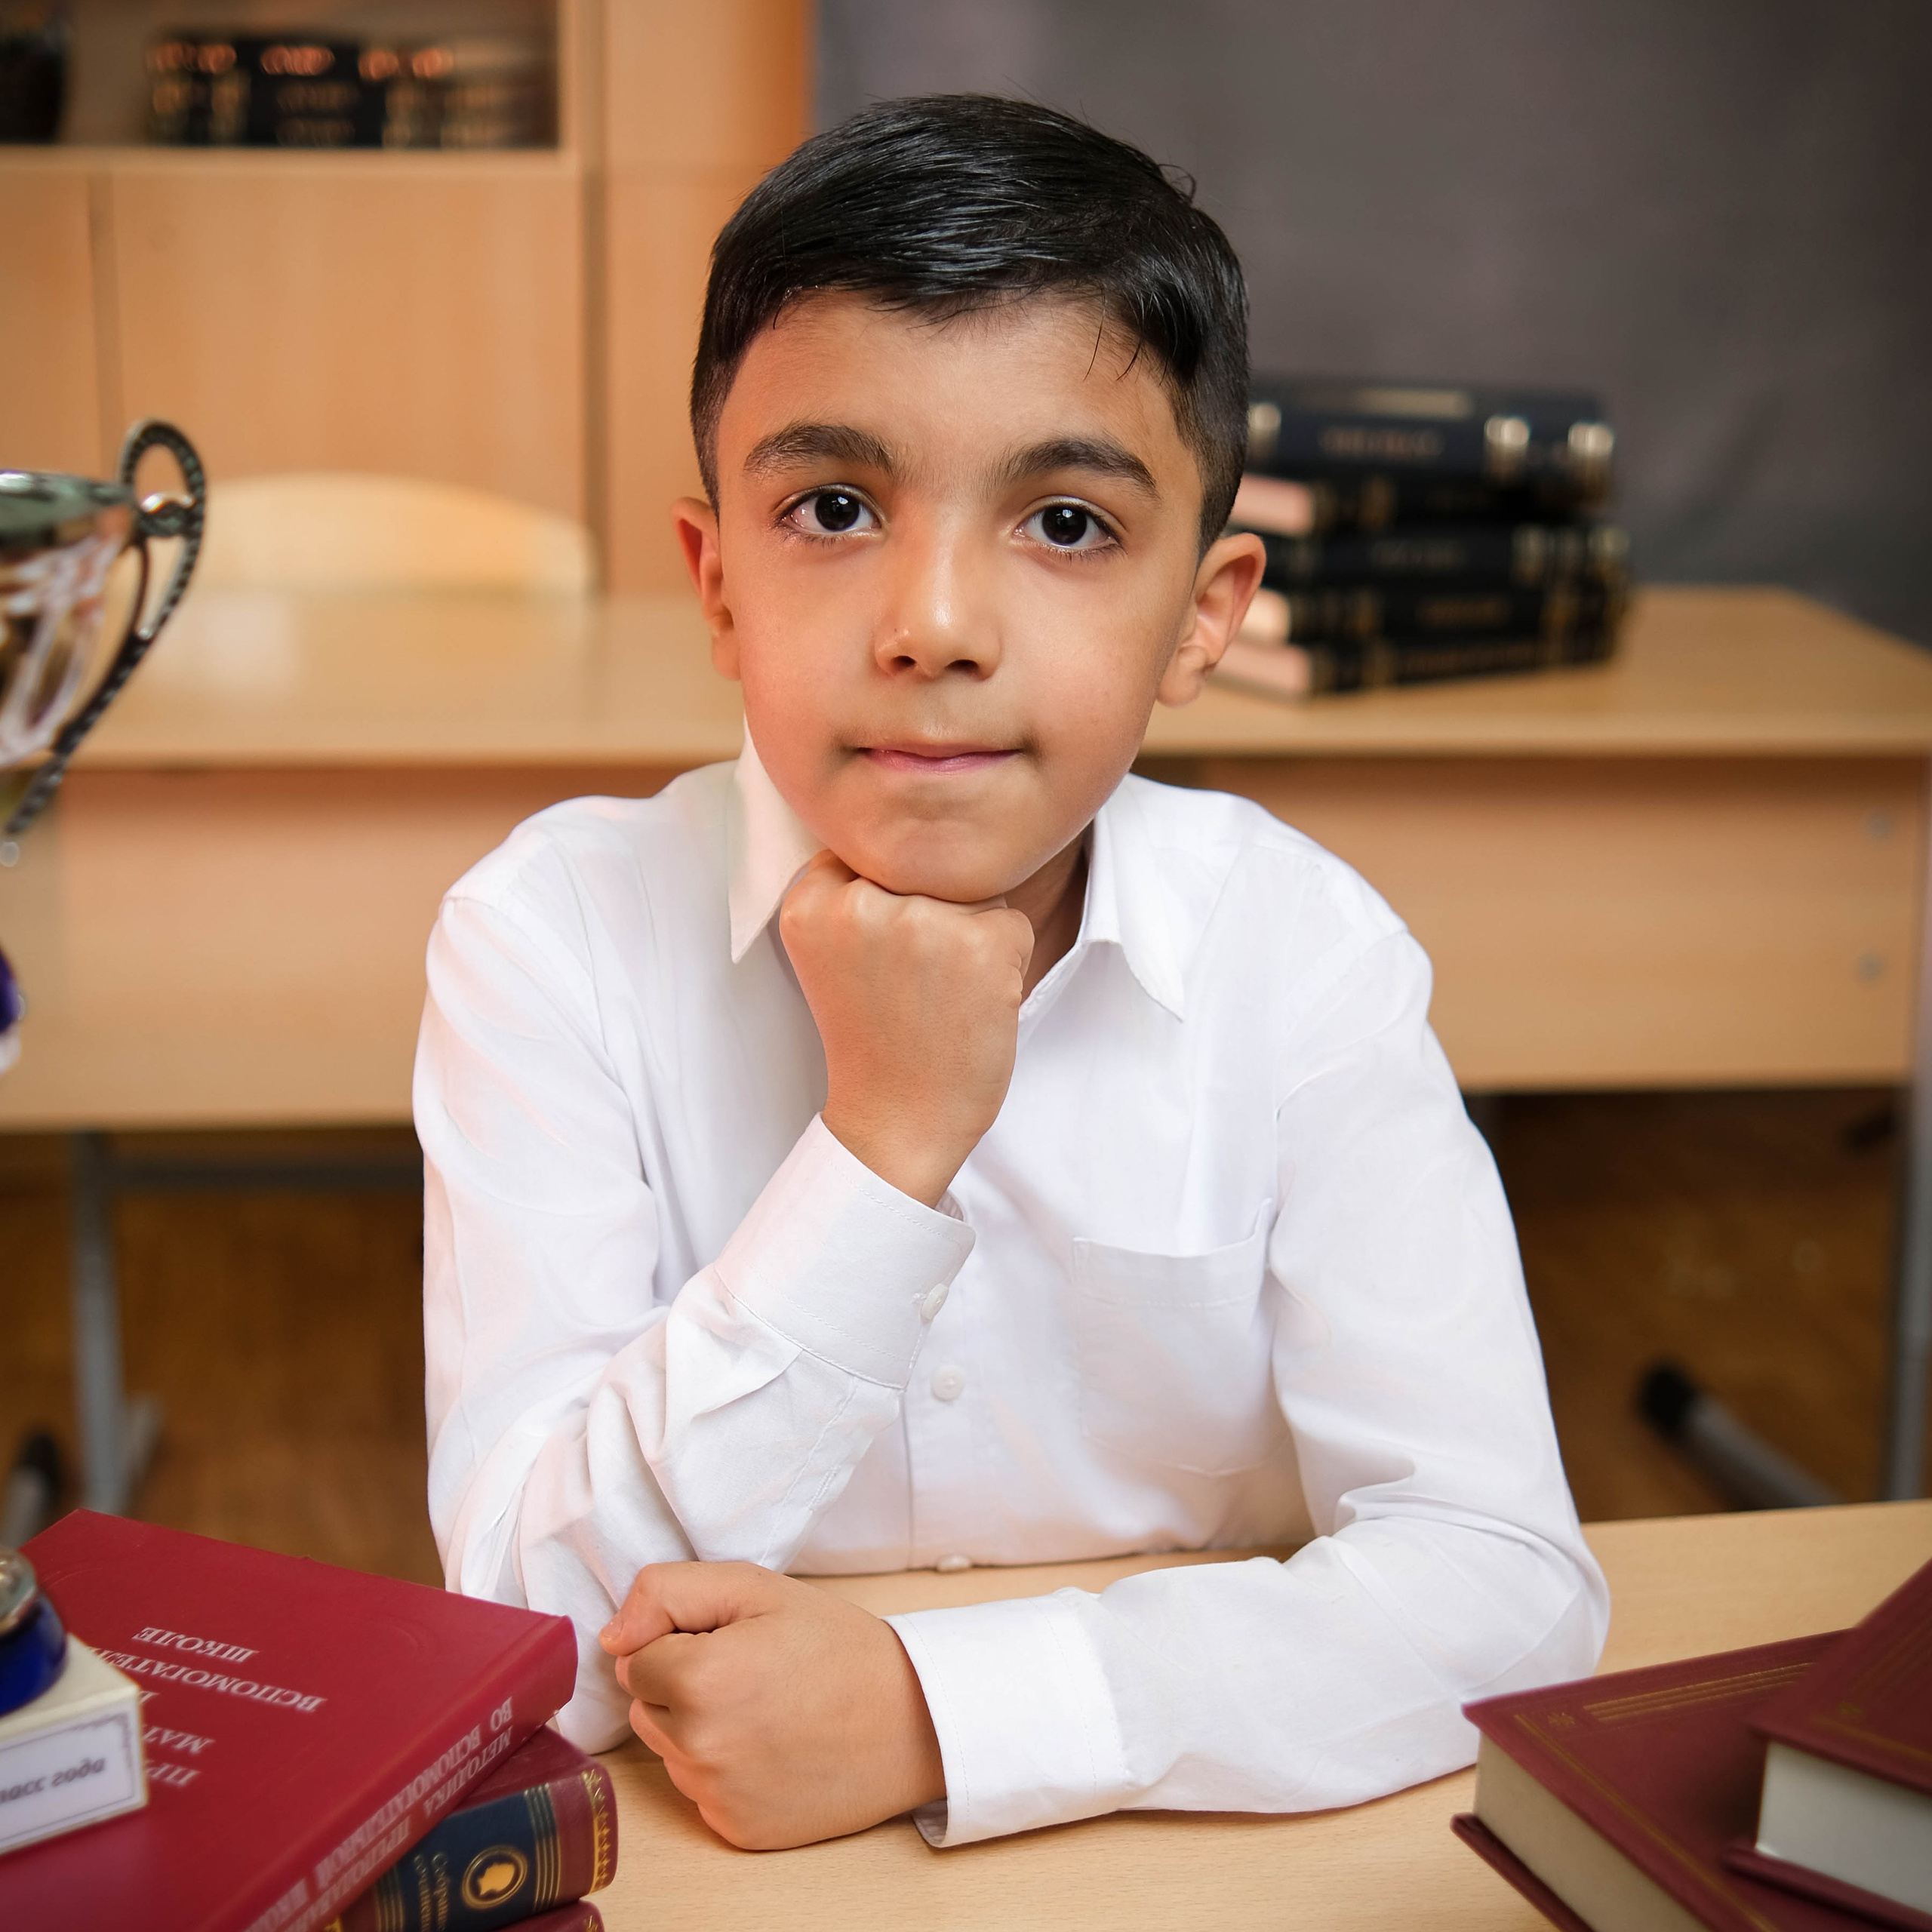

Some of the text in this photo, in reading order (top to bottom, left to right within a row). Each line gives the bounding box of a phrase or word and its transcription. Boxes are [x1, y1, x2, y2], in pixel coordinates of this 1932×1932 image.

[131, 1626, 260, 1662] ШКОЛЕ
[90, 1647, 328, 1712] ВСПОМОГАТЕЛ
[491, 1697, 512, 1732] ВО
[142, 1724, 216, 1754] МАТ
[142, 1759, 201, 1787] ПР
[423, 1725, 513, 1817] МЕТОДИКА
